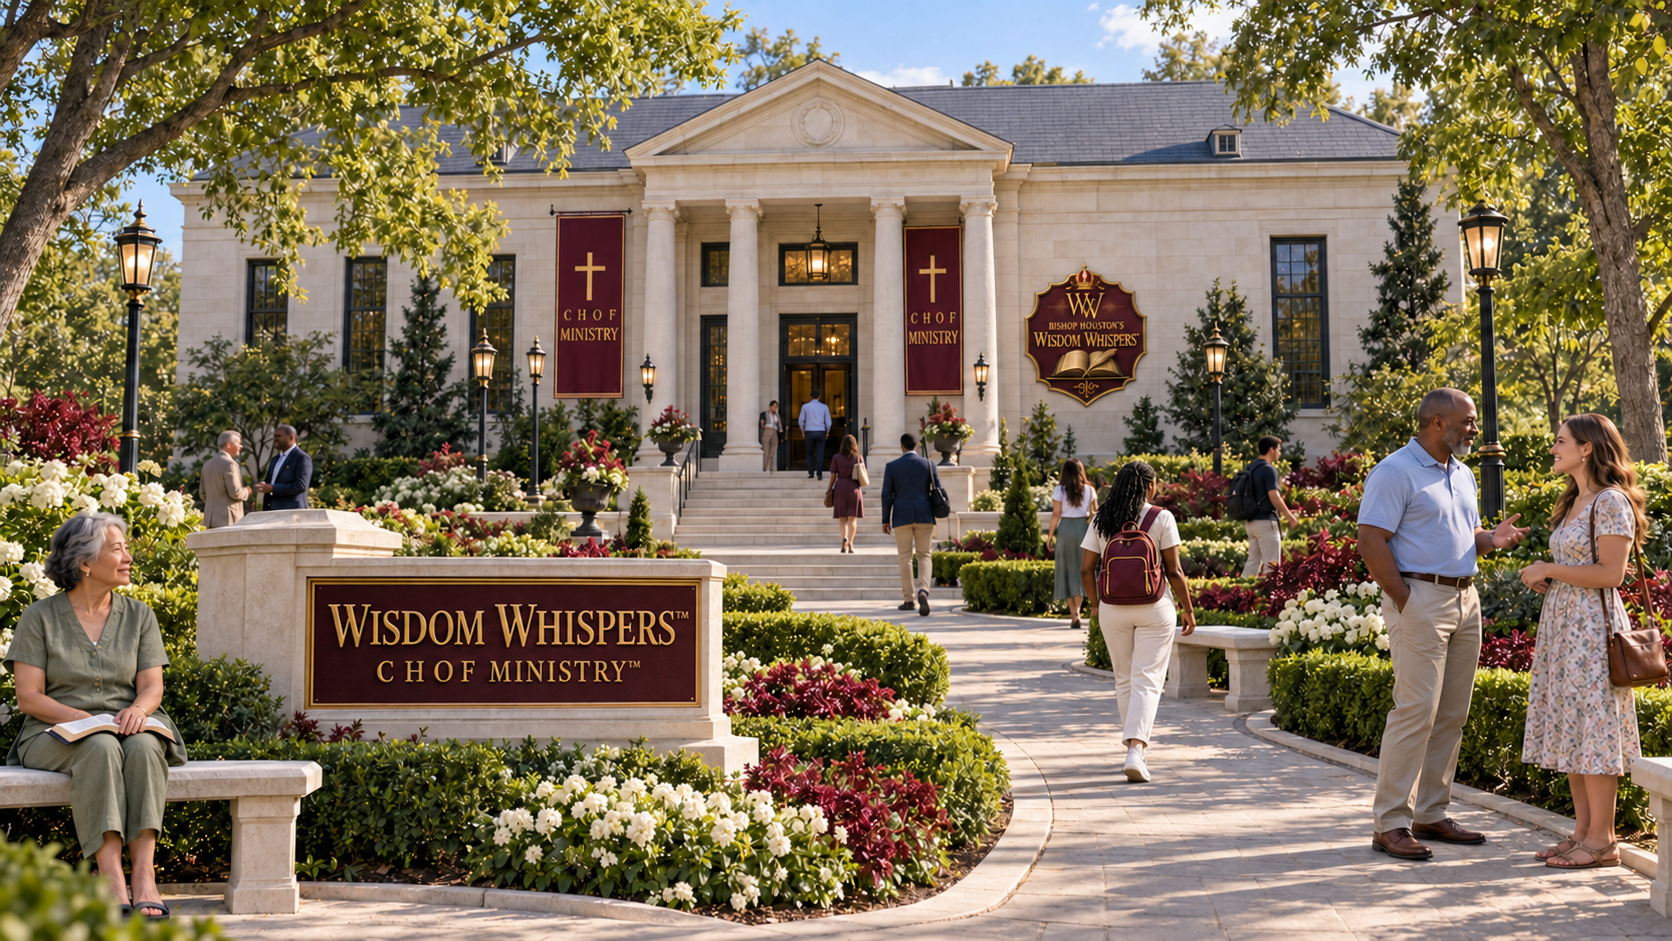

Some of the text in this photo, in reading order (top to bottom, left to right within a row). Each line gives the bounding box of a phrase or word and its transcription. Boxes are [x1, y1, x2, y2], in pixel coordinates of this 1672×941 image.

[560, 327, 619, 341] MINISTRY
[908, 330, 959, 345] MINISTRY
[1033, 332, 1081, 347] WISDOM
[328, 603, 486, 648] WISDOM
